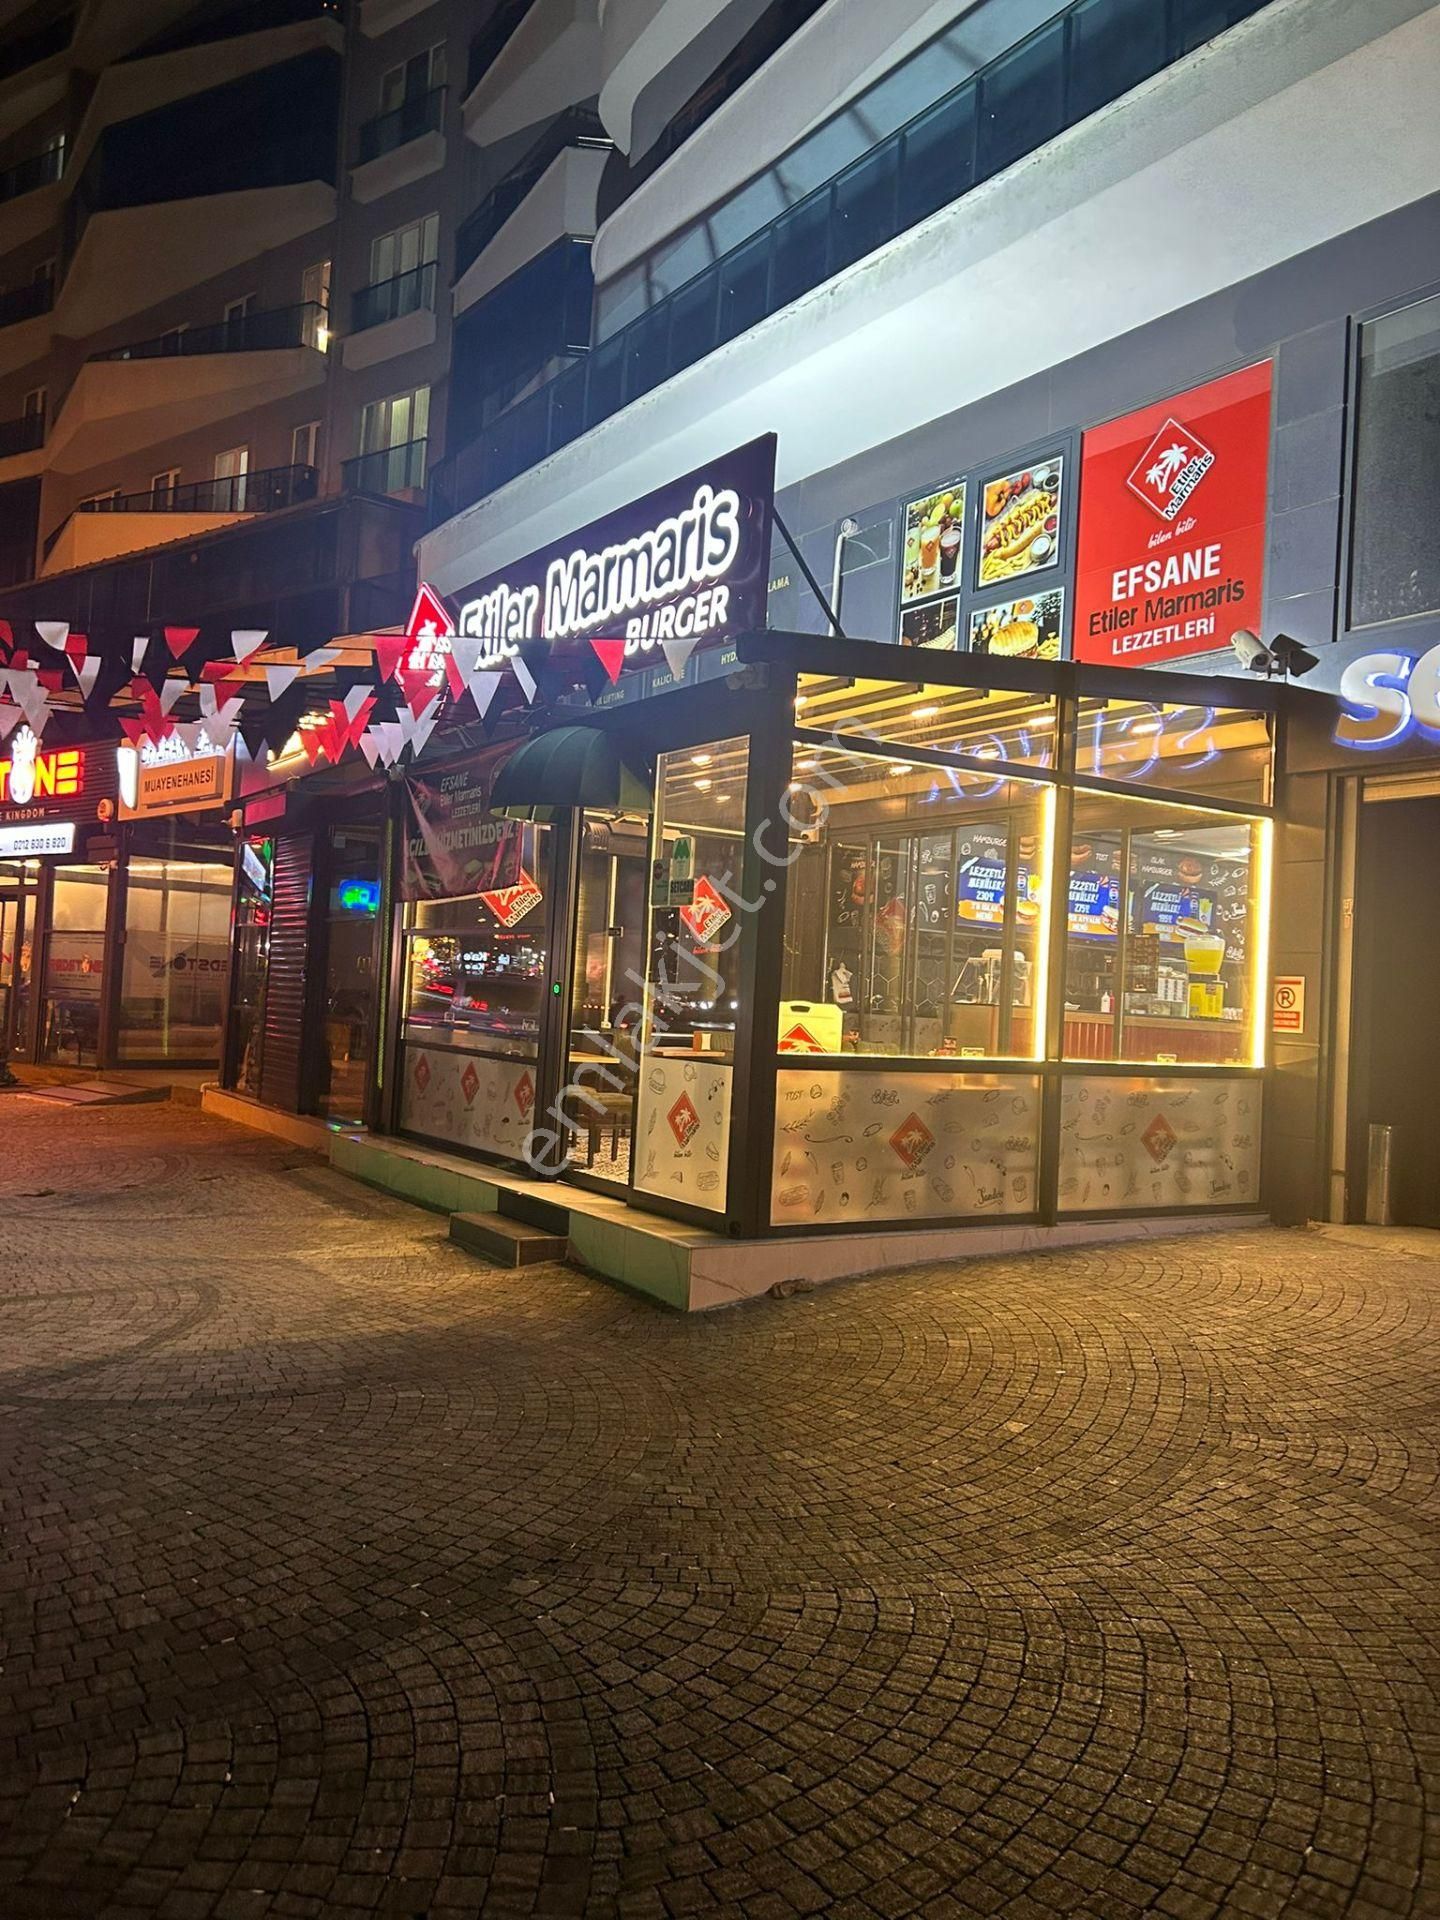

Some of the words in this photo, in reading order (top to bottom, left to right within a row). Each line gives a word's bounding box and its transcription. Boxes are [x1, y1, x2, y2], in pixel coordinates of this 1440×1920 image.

[1164, 453, 1213, 518] Marmaris
[1171, 457, 1199, 495] Etiler
[1148, 530, 1172, 549] bilen
[1175, 517, 1198, 535] bilir
[544, 485, 740, 638] Marmaris
[1112, 544, 1221, 601] EFSANE
[623, 585, 731, 657] BURGER
[1089, 606, 1138, 637] Etiler
[1145, 578, 1245, 623] Marmaris
[1112, 612, 1215, 655] LEZZETLERİ
[144, 766, 214, 793] MUAYENEHANESİ
[440, 772, 469, 793] EFSANE
[6, 808, 45, 820] KINGDOM
[14, 840, 29, 851] 0212
[505, 893, 541, 926] Marmaris
[510, 892, 531, 911] Etiler
